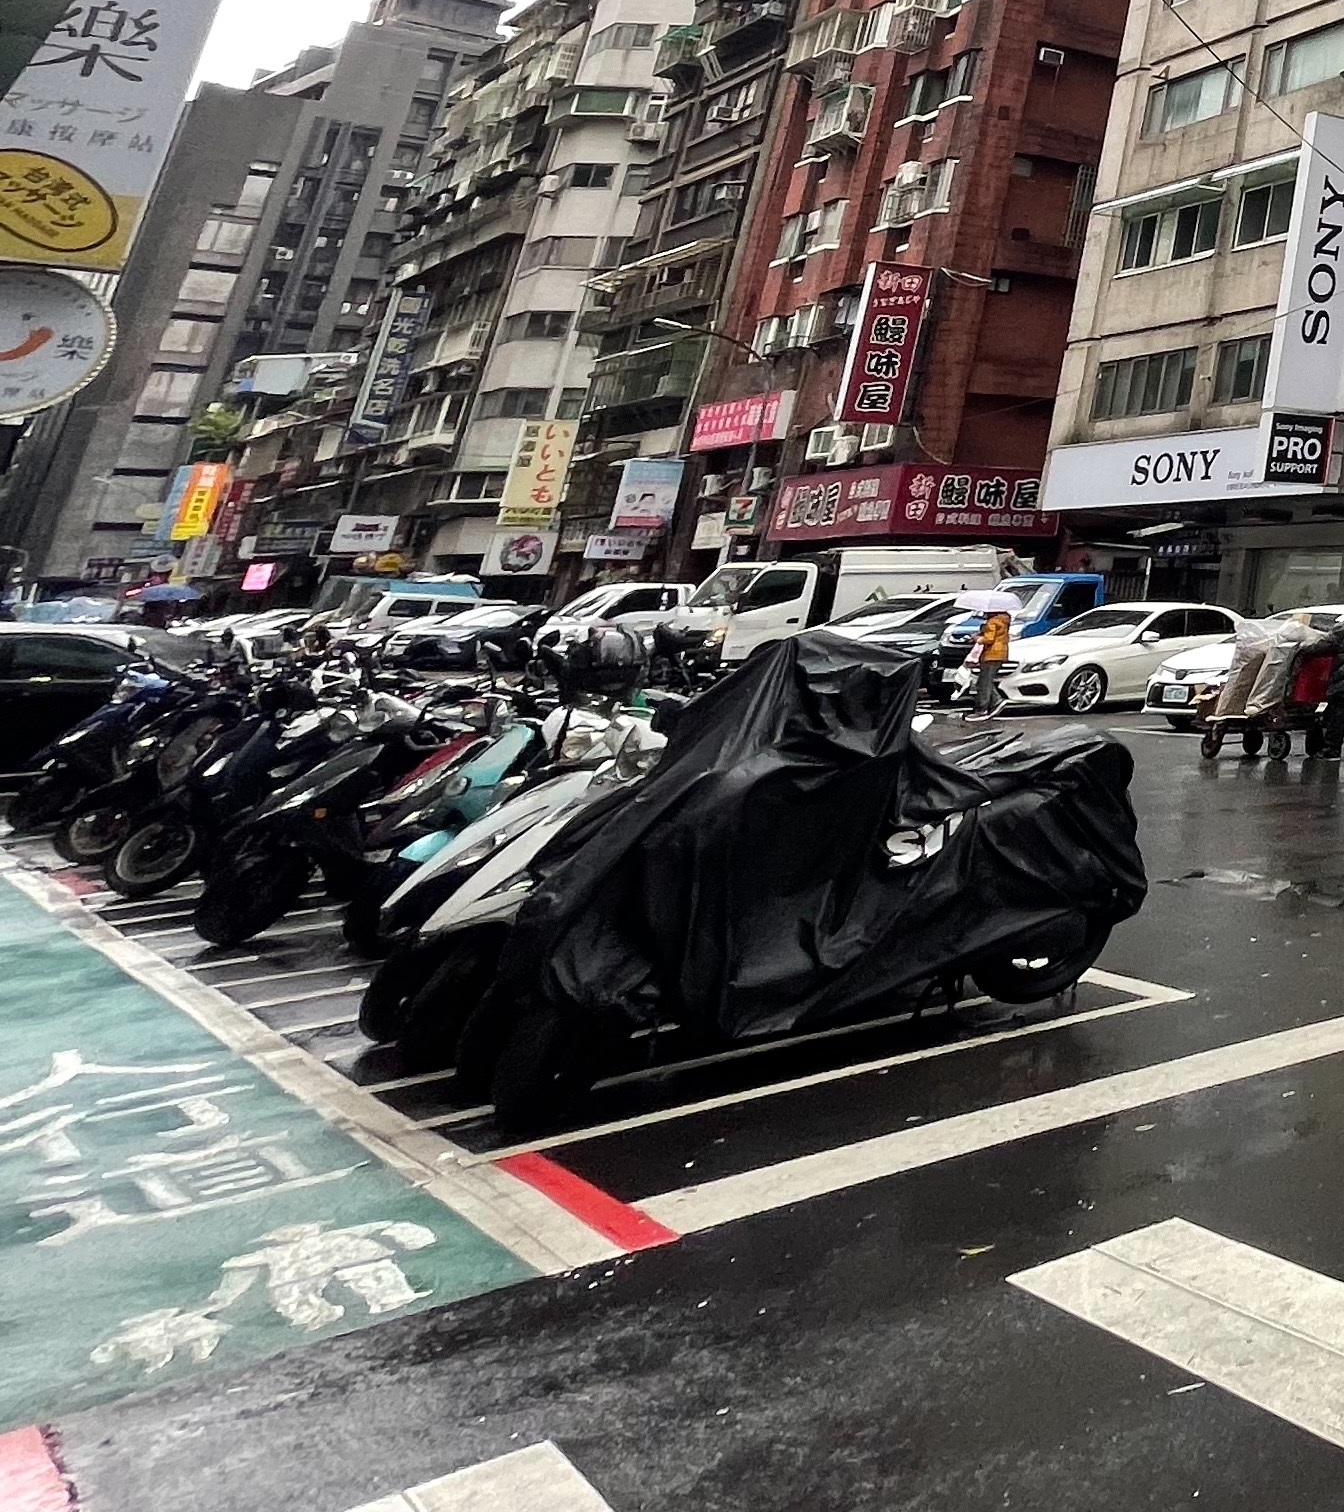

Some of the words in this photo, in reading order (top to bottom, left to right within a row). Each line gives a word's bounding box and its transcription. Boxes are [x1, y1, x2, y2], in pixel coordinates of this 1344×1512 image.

[1275, 422, 1294, 433] Sony
[1271, 435, 1322, 461] PRO
[530, 423, 570, 504] いいとも
[1130, 448, 1222, 487] SONY
[1269, 461, 1319, 475] SUPPORT
